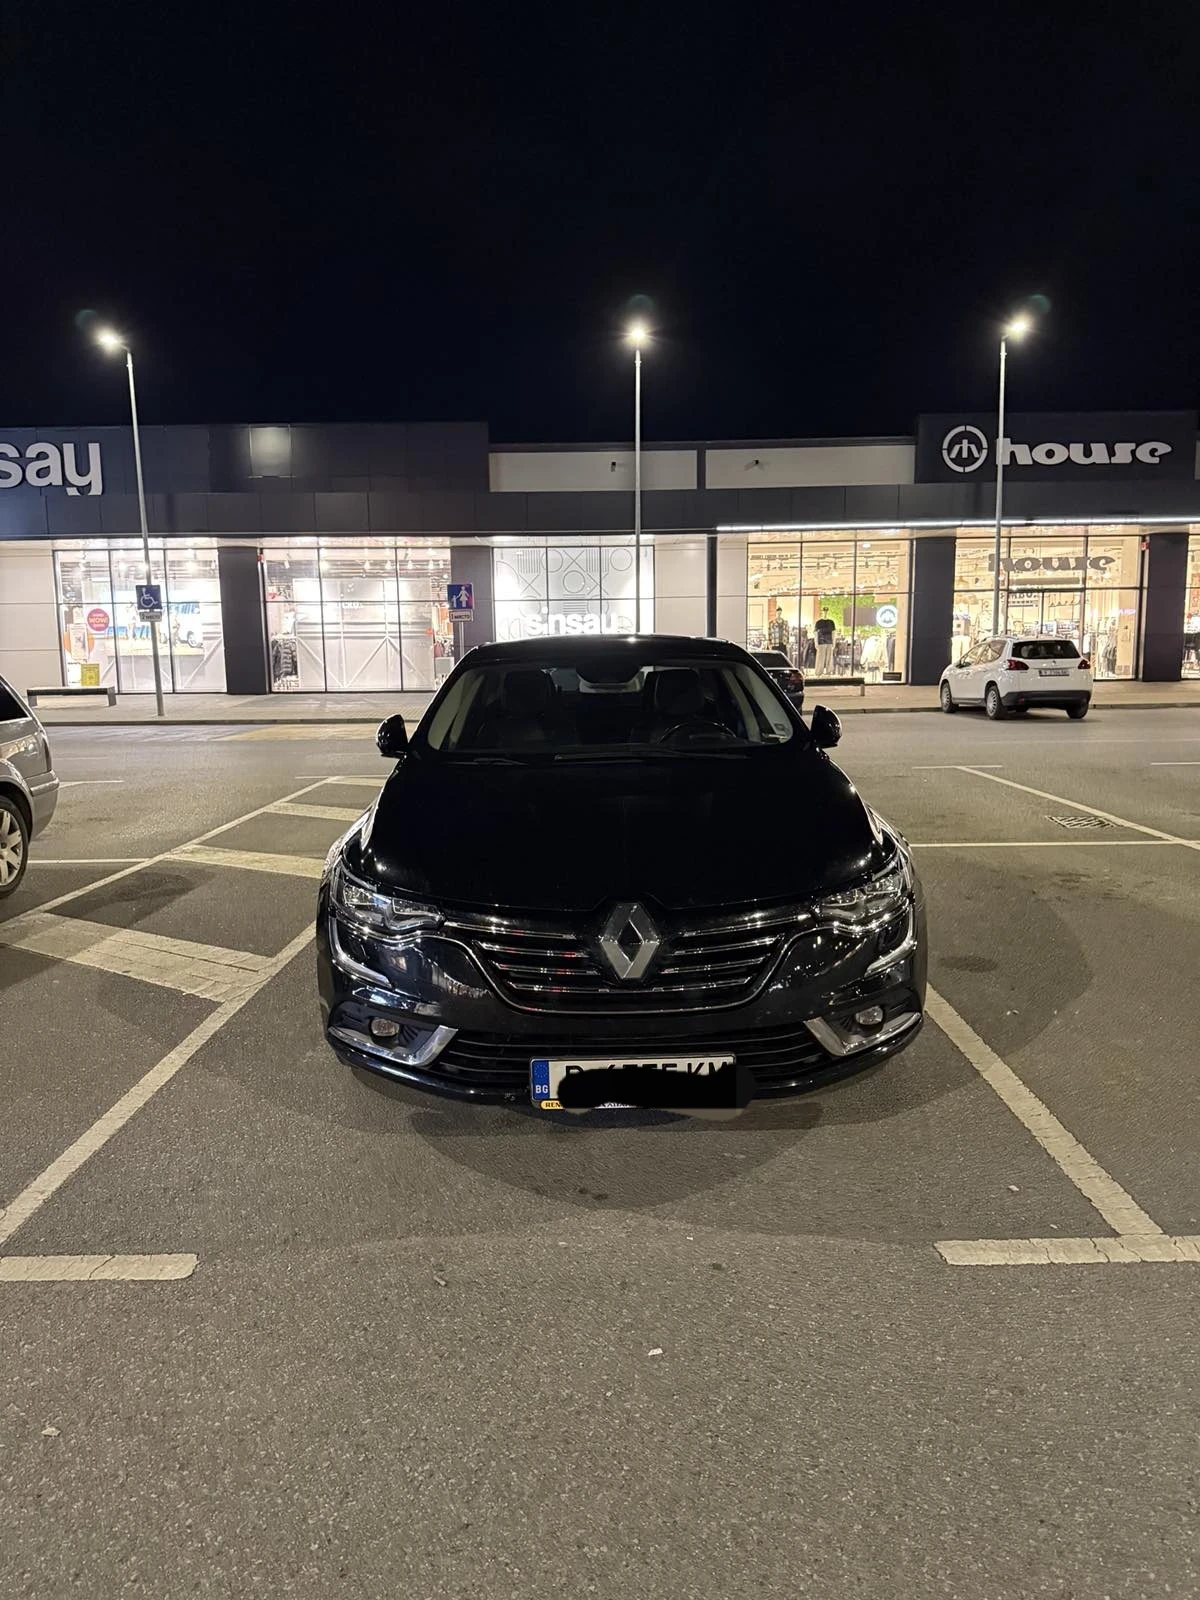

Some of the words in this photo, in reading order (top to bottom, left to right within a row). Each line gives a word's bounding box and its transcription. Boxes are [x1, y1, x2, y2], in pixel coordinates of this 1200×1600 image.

[996, 437, 1172, 465] house
[988, 553, 1115, 572] house
[535, 1085, 548, 1094] BG
